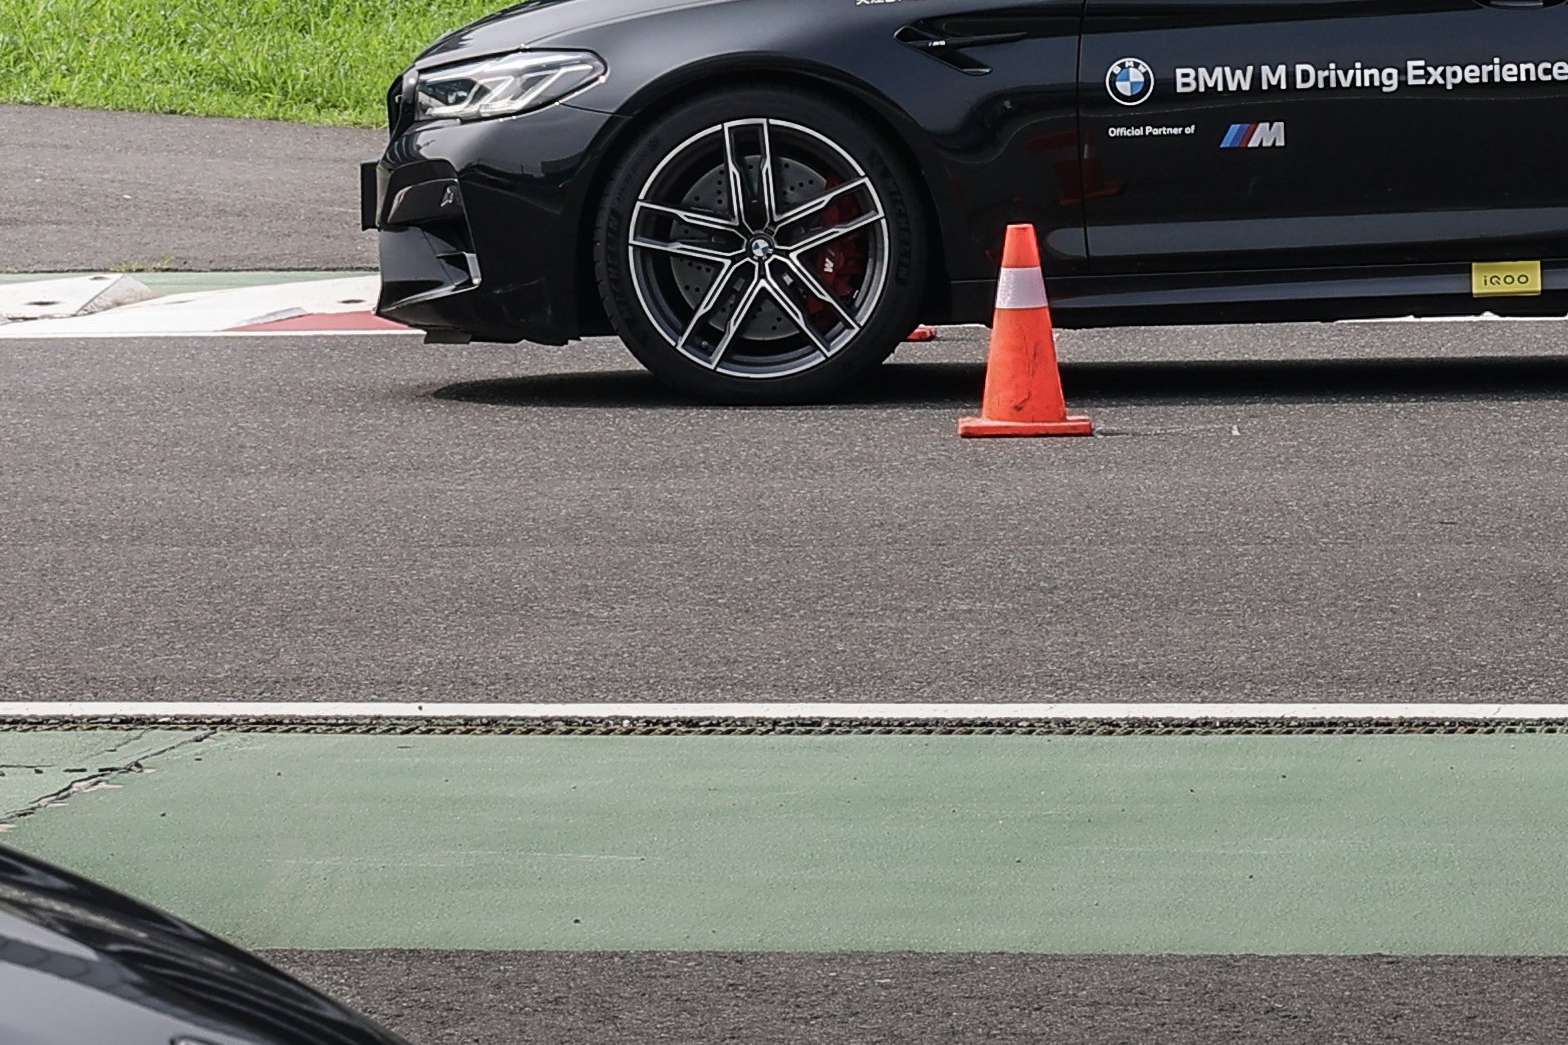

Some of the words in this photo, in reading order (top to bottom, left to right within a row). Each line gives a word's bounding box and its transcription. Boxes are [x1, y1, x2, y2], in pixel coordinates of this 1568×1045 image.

[1175, 65, 1254, 93] BMW
[1260, 64, 1287, 90] M
[1295, 61, 1399, 93] Driving
[1108, 126, 1144, 137] Official
[1145, 125, 1183, 136] Partner
[1184, 124, 1196, 135] of
[1484, 274, 1529, 286] iQOO
